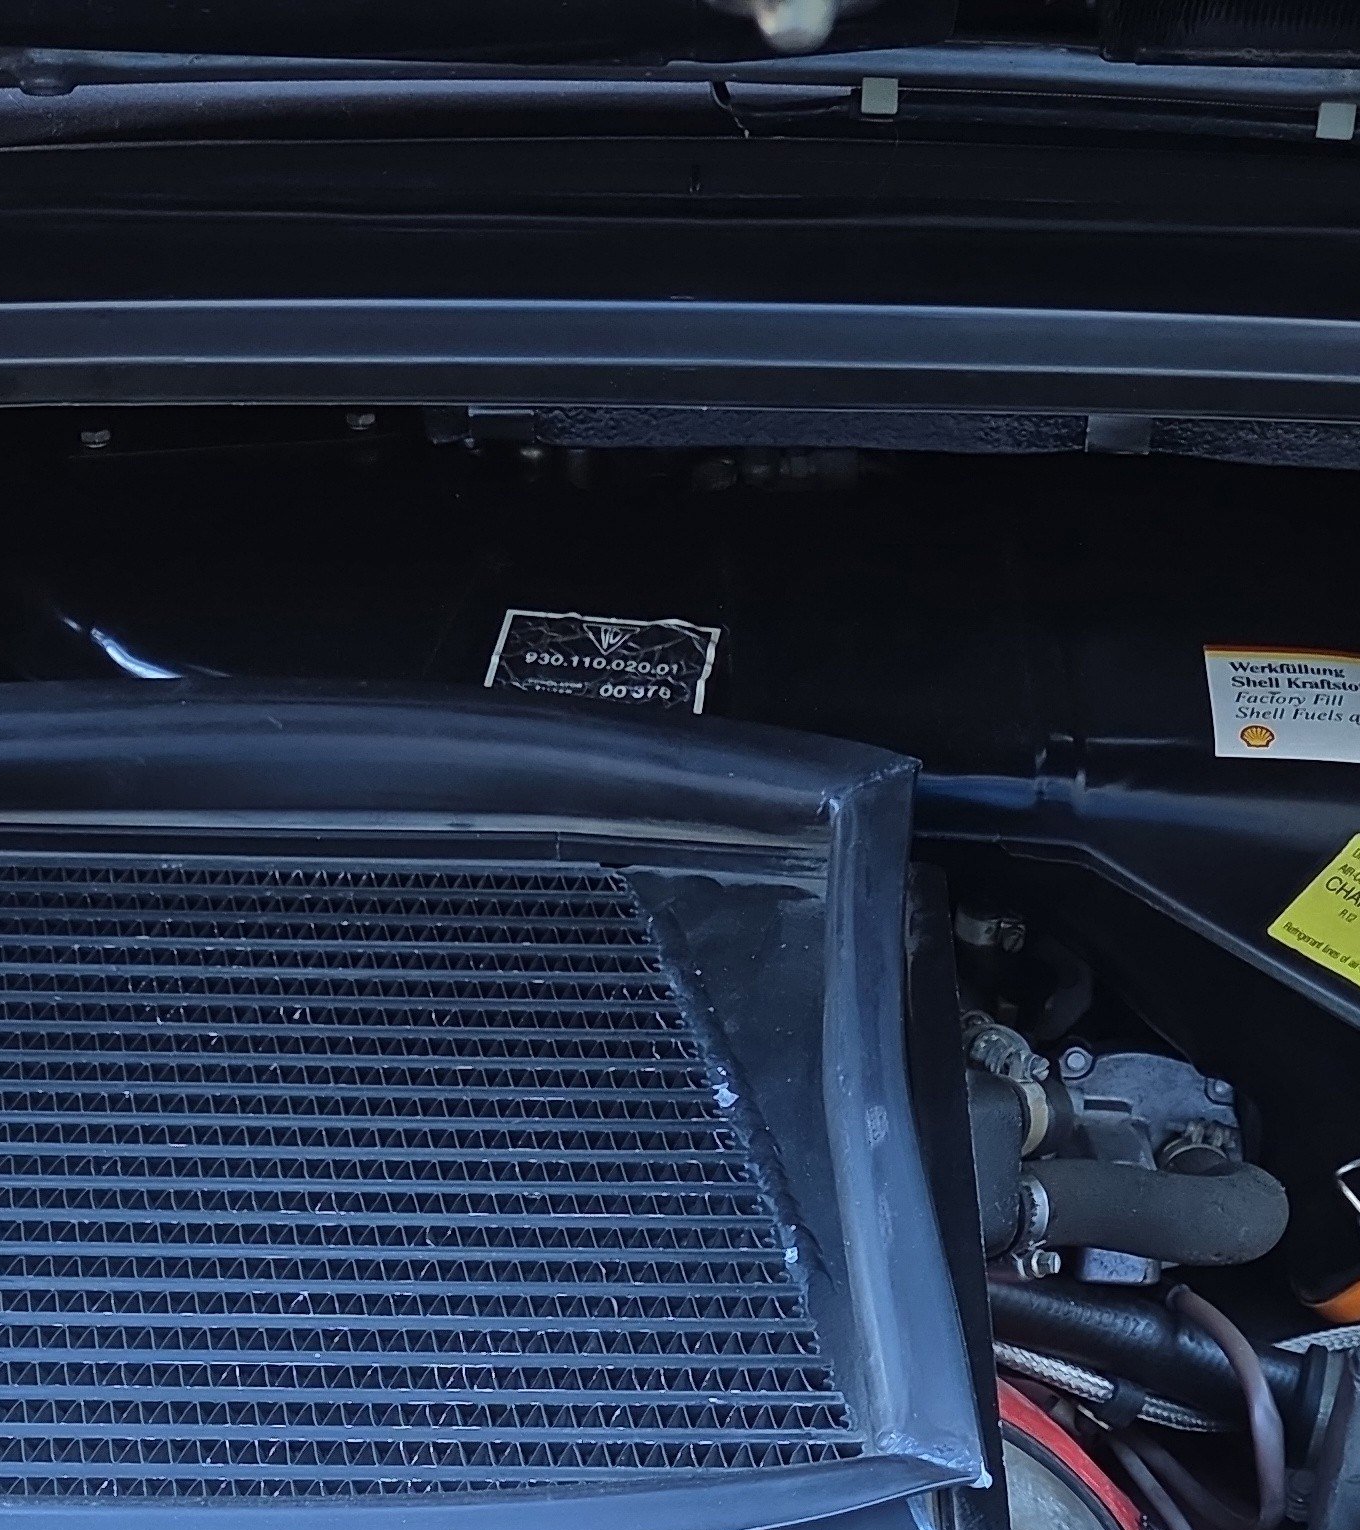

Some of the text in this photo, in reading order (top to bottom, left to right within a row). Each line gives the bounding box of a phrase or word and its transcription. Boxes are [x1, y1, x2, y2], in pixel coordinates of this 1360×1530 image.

[525, 652, 679, 676] 930.110.020.01
[1229, 661, 1346, 679] Werkfüllung
[1231, 675, 1280, 689] Shell
[1235, 691, 1344, 708] Factory Fill
[1235, 706, 1285, 720] Shell
[1292, 707, 1343, 722] Fuels
